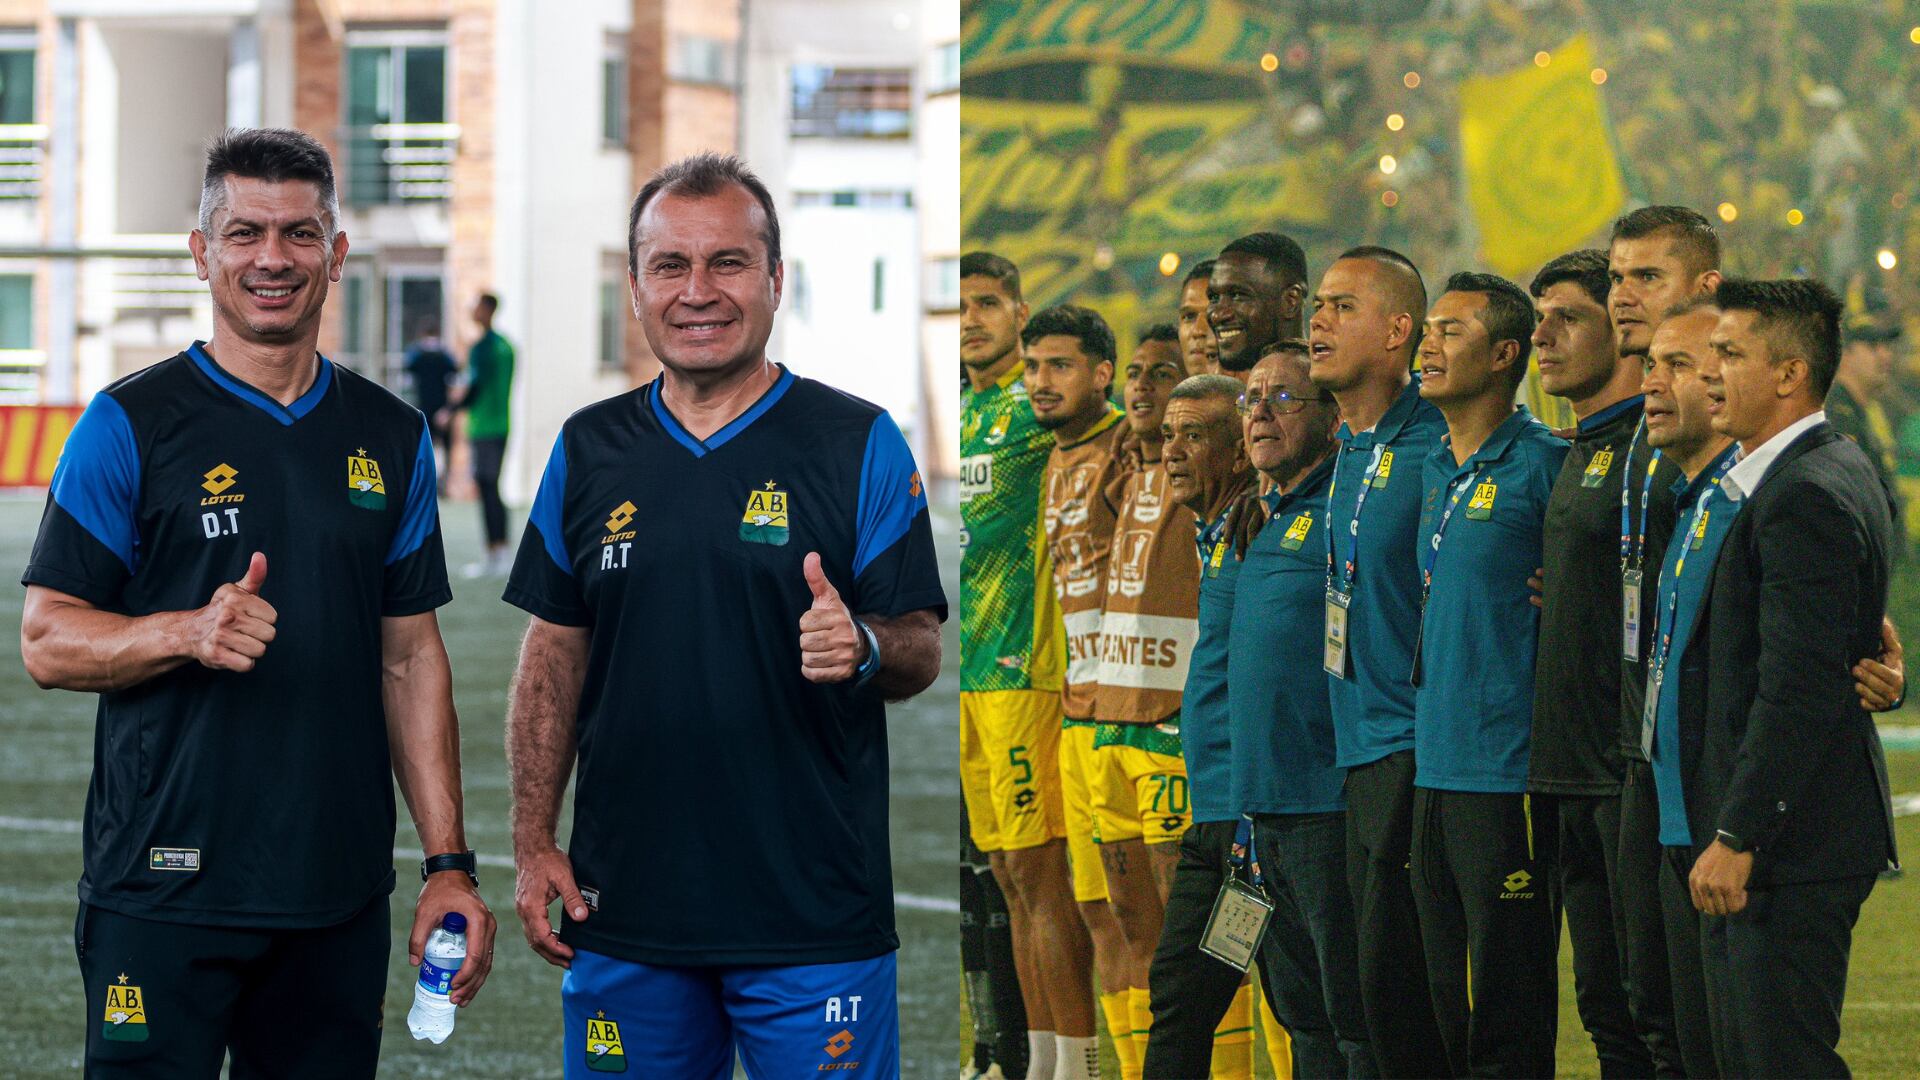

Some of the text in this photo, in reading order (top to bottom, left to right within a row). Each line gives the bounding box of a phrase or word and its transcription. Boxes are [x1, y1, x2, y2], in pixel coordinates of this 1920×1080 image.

[200, 494, 245, 506] LOTTO
[201, 507, 240, 539] D.T
[601, 530, 637, 544] LOTTO
[601, 542, 632, 571] A.T
[1009, 745, 1032, 785] 5
[1150, 774, 1188, 814] 70
[108, 987, 141, 1009] A.B.
[825, 995, 862, 1022] A.T
[588, 1021, 619, 1042] A.B.
